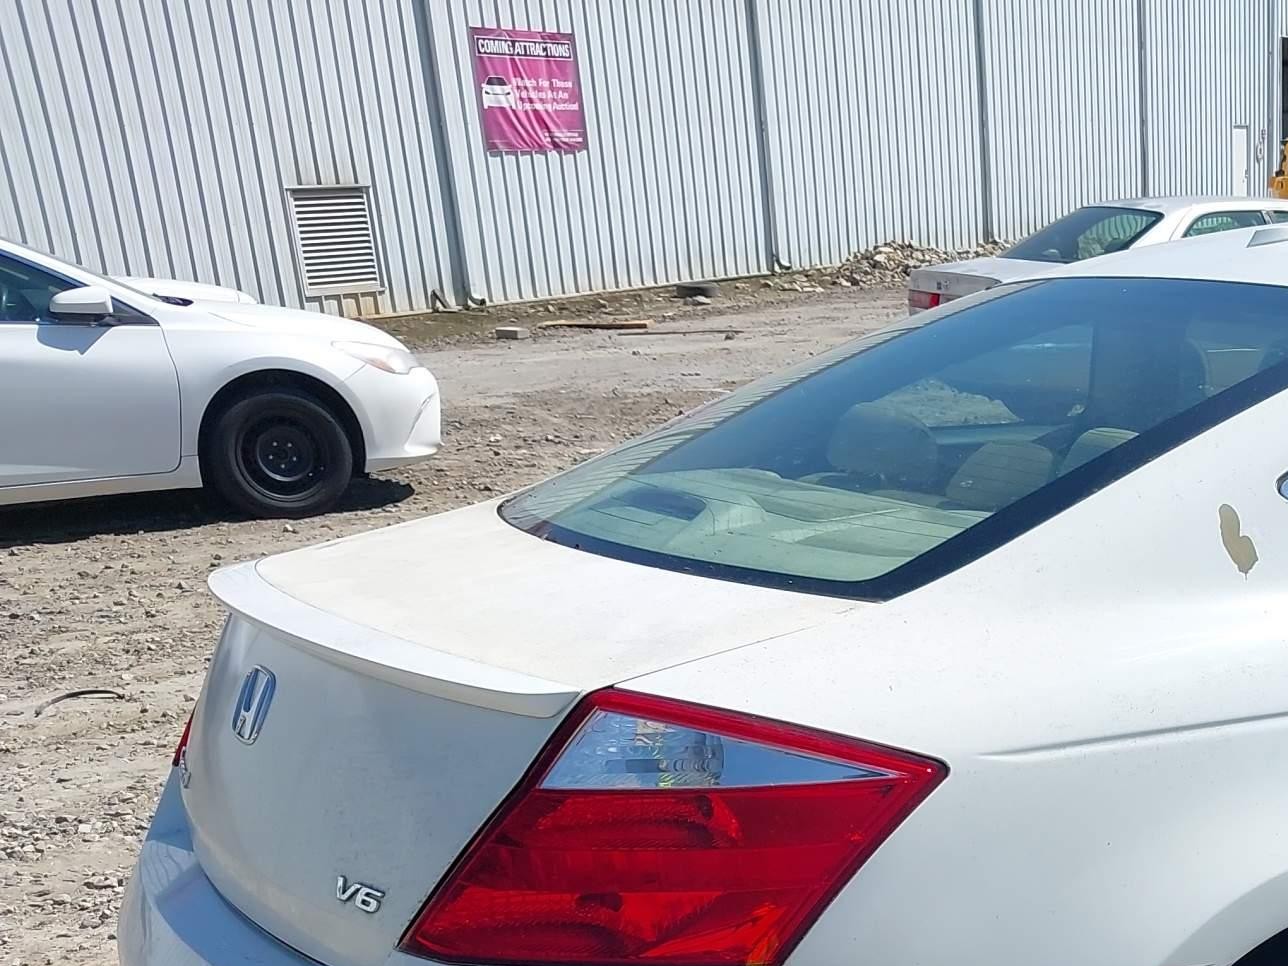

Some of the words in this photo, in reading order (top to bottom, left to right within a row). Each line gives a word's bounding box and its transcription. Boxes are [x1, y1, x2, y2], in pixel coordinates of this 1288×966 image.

[478, 39, 513, 54] COMING
[514, 42, 570, 58] ATTRACTIONS
[336, 875, 385, 913] V6
